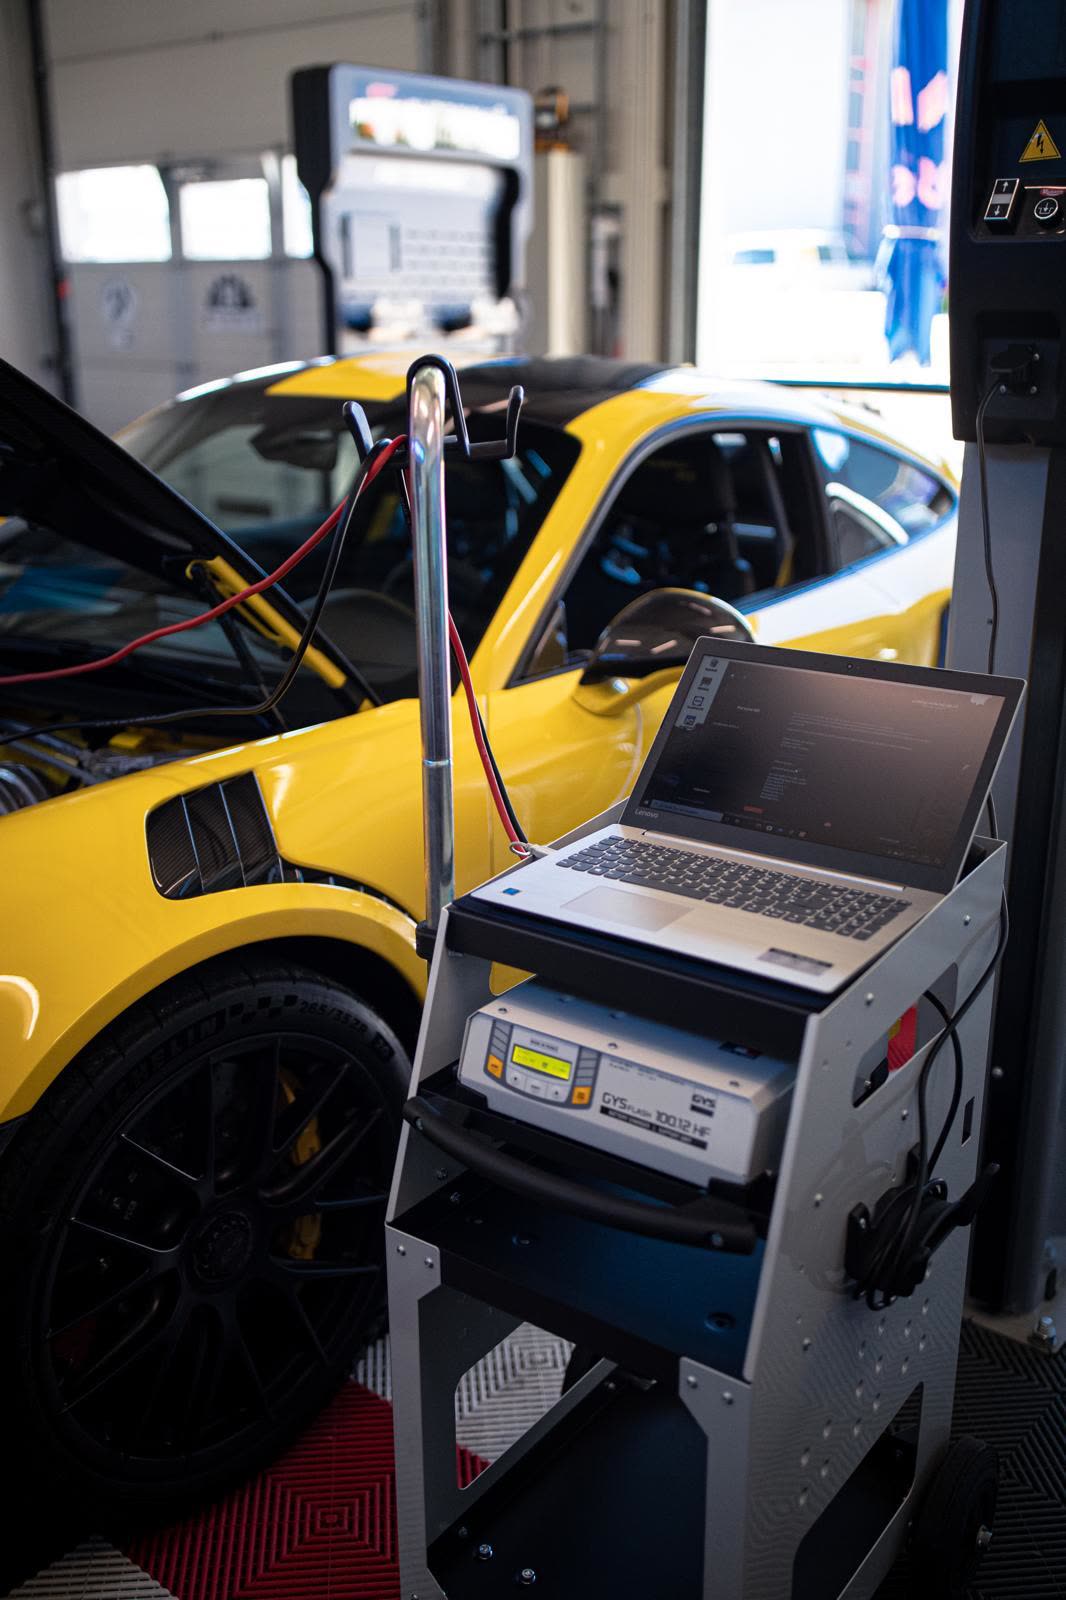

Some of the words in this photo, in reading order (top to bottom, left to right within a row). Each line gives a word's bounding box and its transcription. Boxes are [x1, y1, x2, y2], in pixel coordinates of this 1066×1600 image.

[634, 808, 659, 819] Lenovo
[692, 1094, 716, 1108] GYS
[692, 1123, 711, 1137] HF
